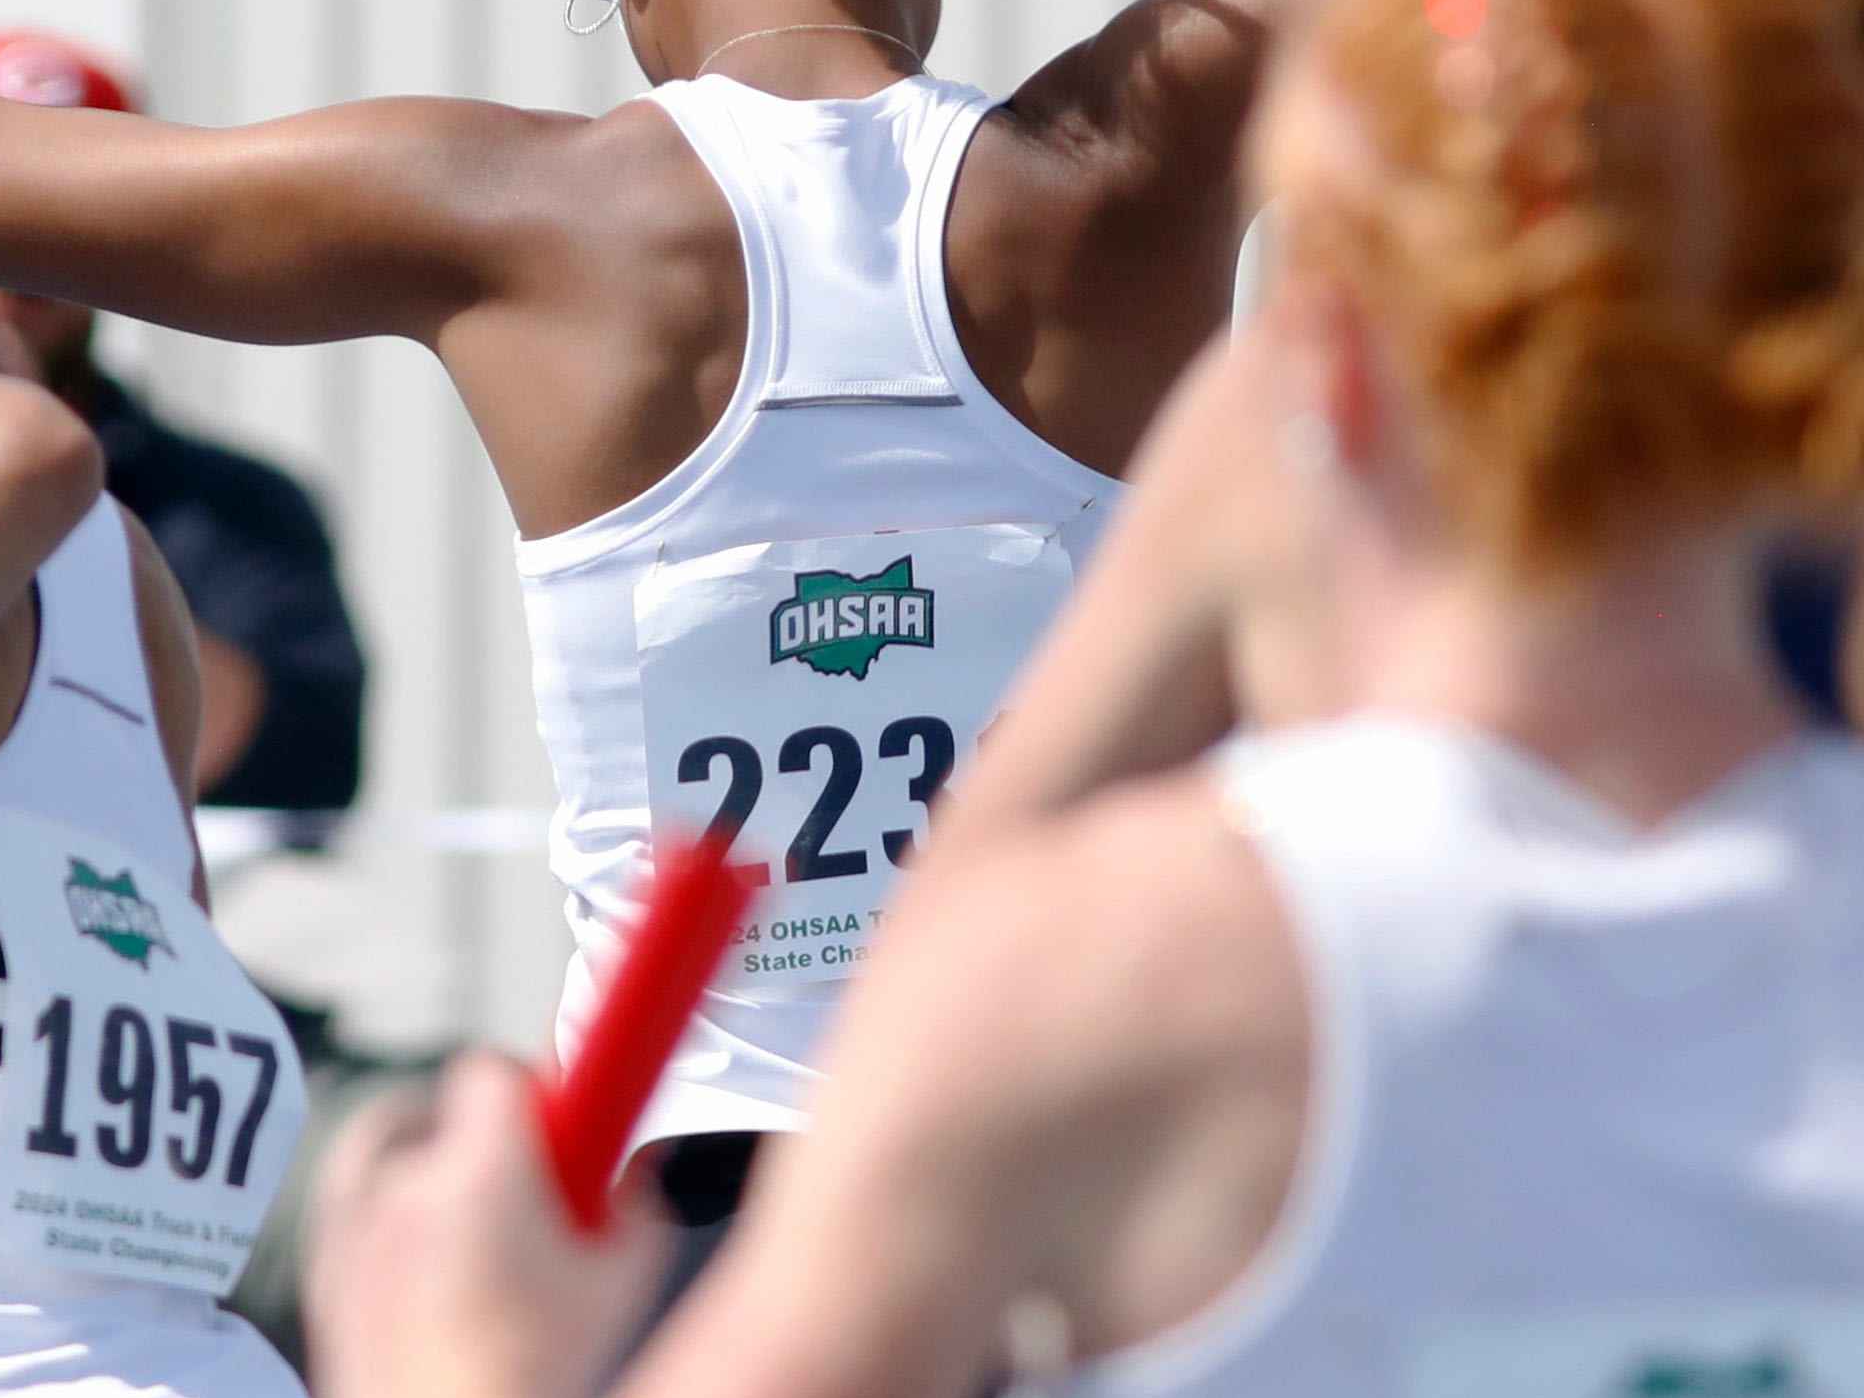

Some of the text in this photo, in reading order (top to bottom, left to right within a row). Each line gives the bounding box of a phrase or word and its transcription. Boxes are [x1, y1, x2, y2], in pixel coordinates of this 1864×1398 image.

[780, 593, 926, 651] OHSAA
[677, 710, 998, 888] 223
[770, 913, 861, 941] OHSAA
[744, 951, 812, 973] State
[26, 993, 278, 1188] 1957
